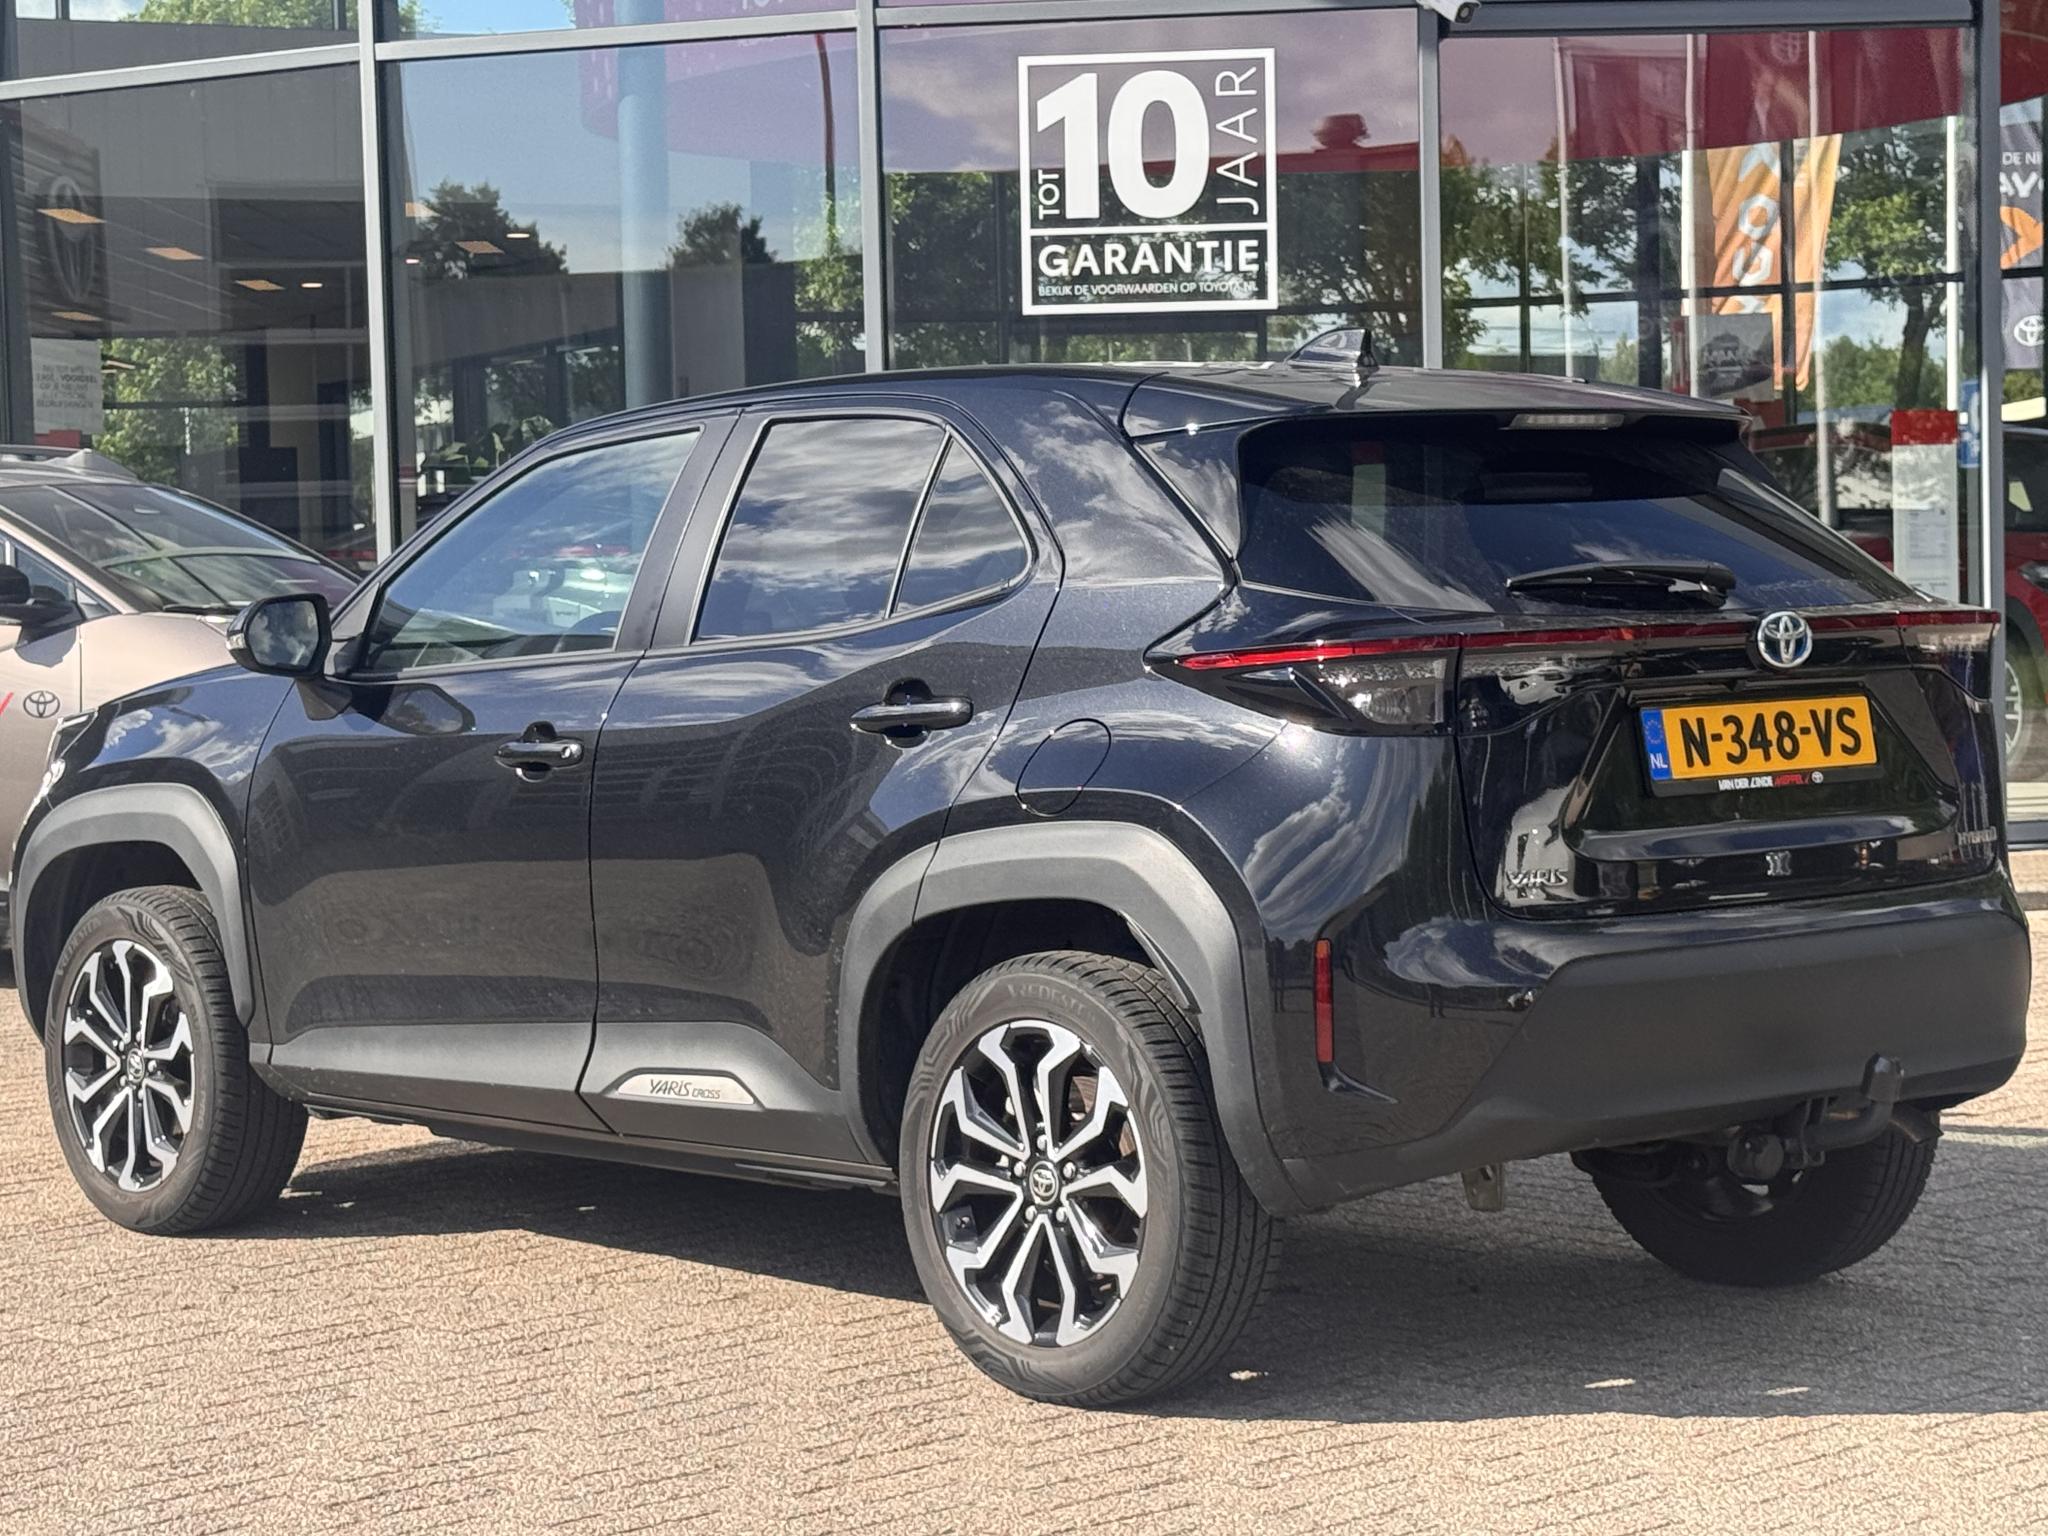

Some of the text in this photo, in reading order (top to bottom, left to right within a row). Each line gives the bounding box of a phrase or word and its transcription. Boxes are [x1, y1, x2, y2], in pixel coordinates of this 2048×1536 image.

[1037, 70, 1210, 219] 10
[1215, 67, 1259, 215] JAAR
[2002, 152, 2023, 166] DE
[1038, 169, 1061, 220] TOT
[1999, 171, 2043, 199] AY
[1038, 240, 1260, 277] GARANTIE
[1074, 283, 1089, 296] DE
[1091, 281, 1178, 295] VOORWAARDEN
[1180, 281, 1197, 293] OP
[1680, 707, 1862, 768] N-348-VS
[1650, 753, 1668, 769] NL
[1718, 779, 1734, 791] VAN
[1735, 778, 1750, 789] DER
[1506, 868, 1569, 889] YARIS
[650, 1078, 721, 1100] YARIS CROSS
